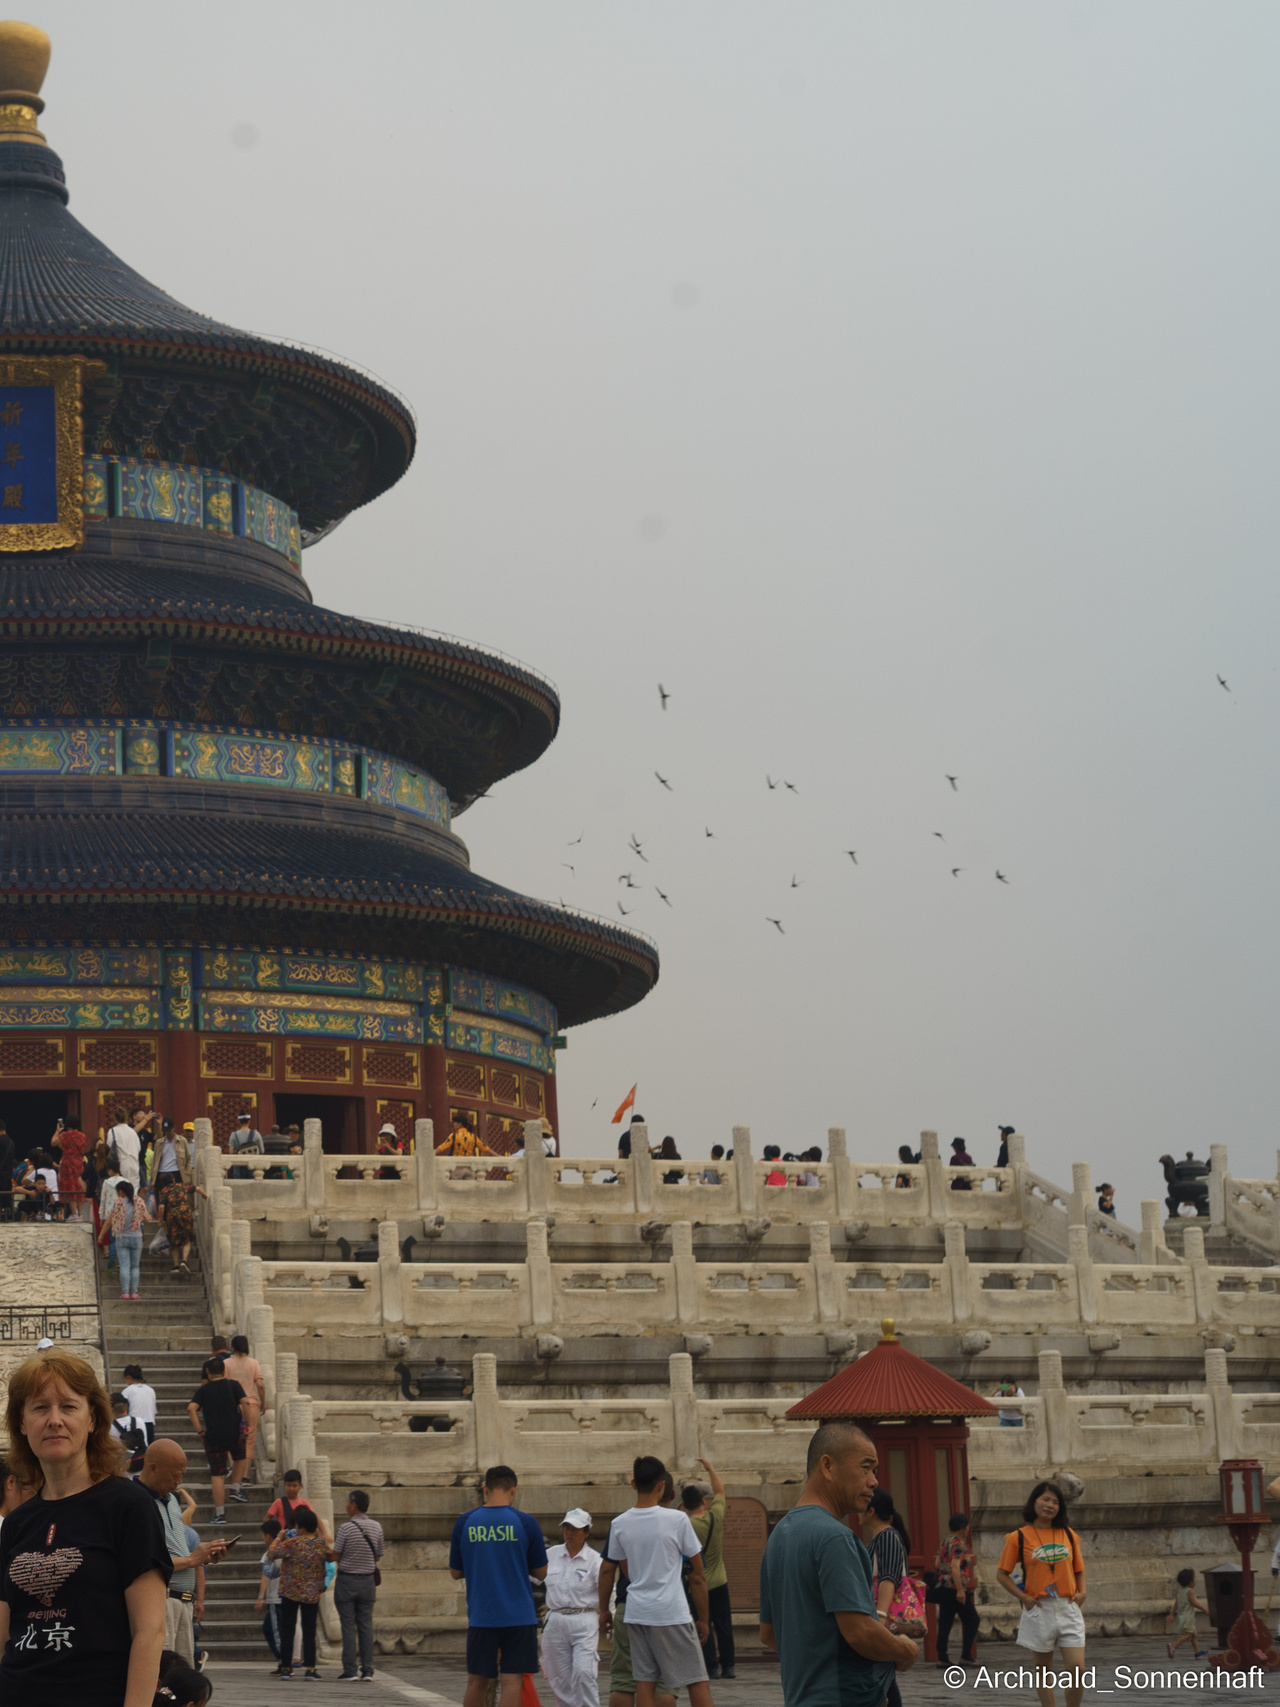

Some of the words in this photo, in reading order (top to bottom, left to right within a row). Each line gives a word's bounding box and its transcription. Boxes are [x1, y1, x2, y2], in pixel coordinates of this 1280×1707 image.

[468, 1525, 519, 1543] BRASIL
[27, 1608, 67, 1622] BEIJING
[14, 1621, 76, 1652] 北京
